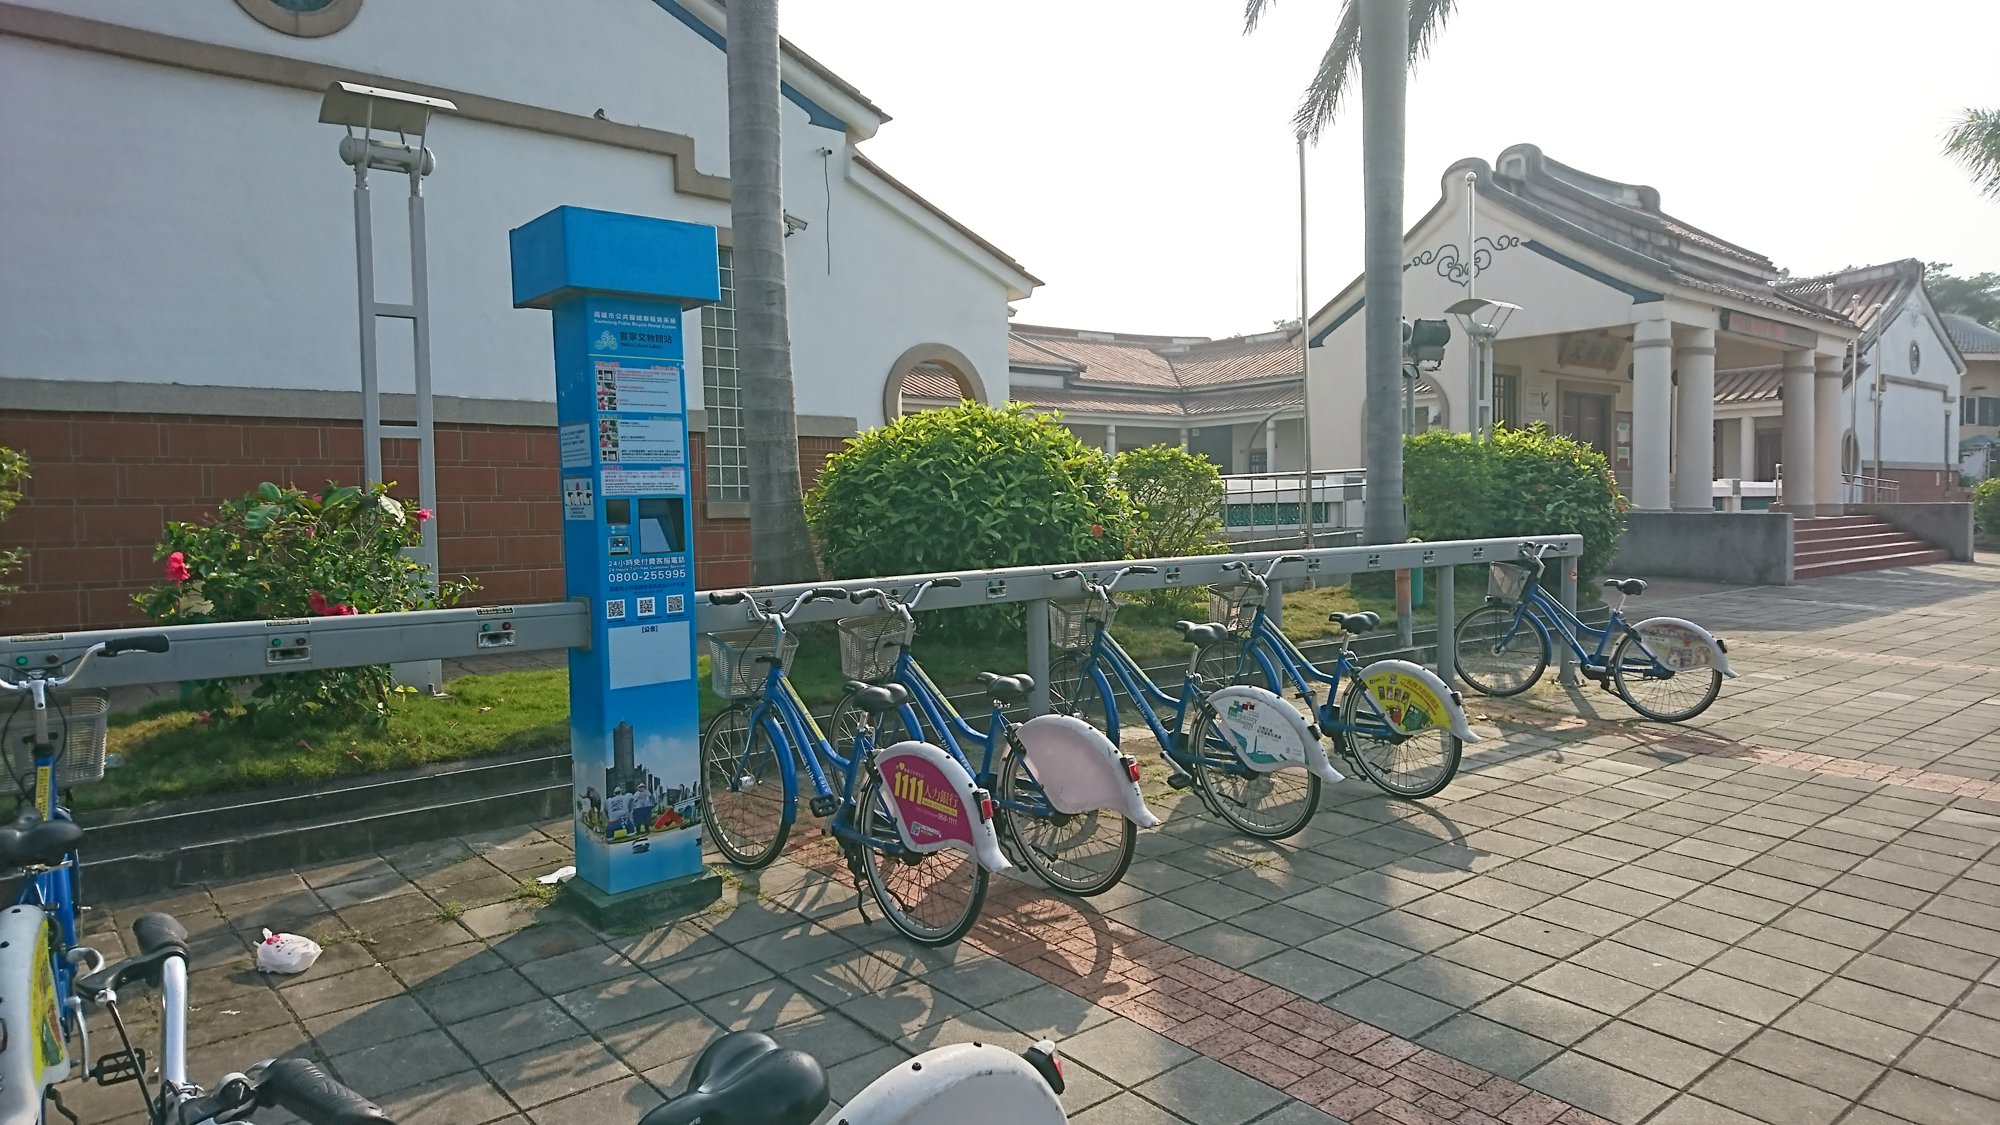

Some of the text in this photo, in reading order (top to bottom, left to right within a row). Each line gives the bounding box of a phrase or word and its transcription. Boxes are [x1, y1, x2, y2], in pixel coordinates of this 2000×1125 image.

[620, 331, 673, 344] 客家文物館站
[608, 556, 686, 567] 24小時免付費客服電話
[608, 569, 686, 583] 0800-255995
[894, 772, 924, 805] 1111
[924, 784, 959, 808] 人力銀行
